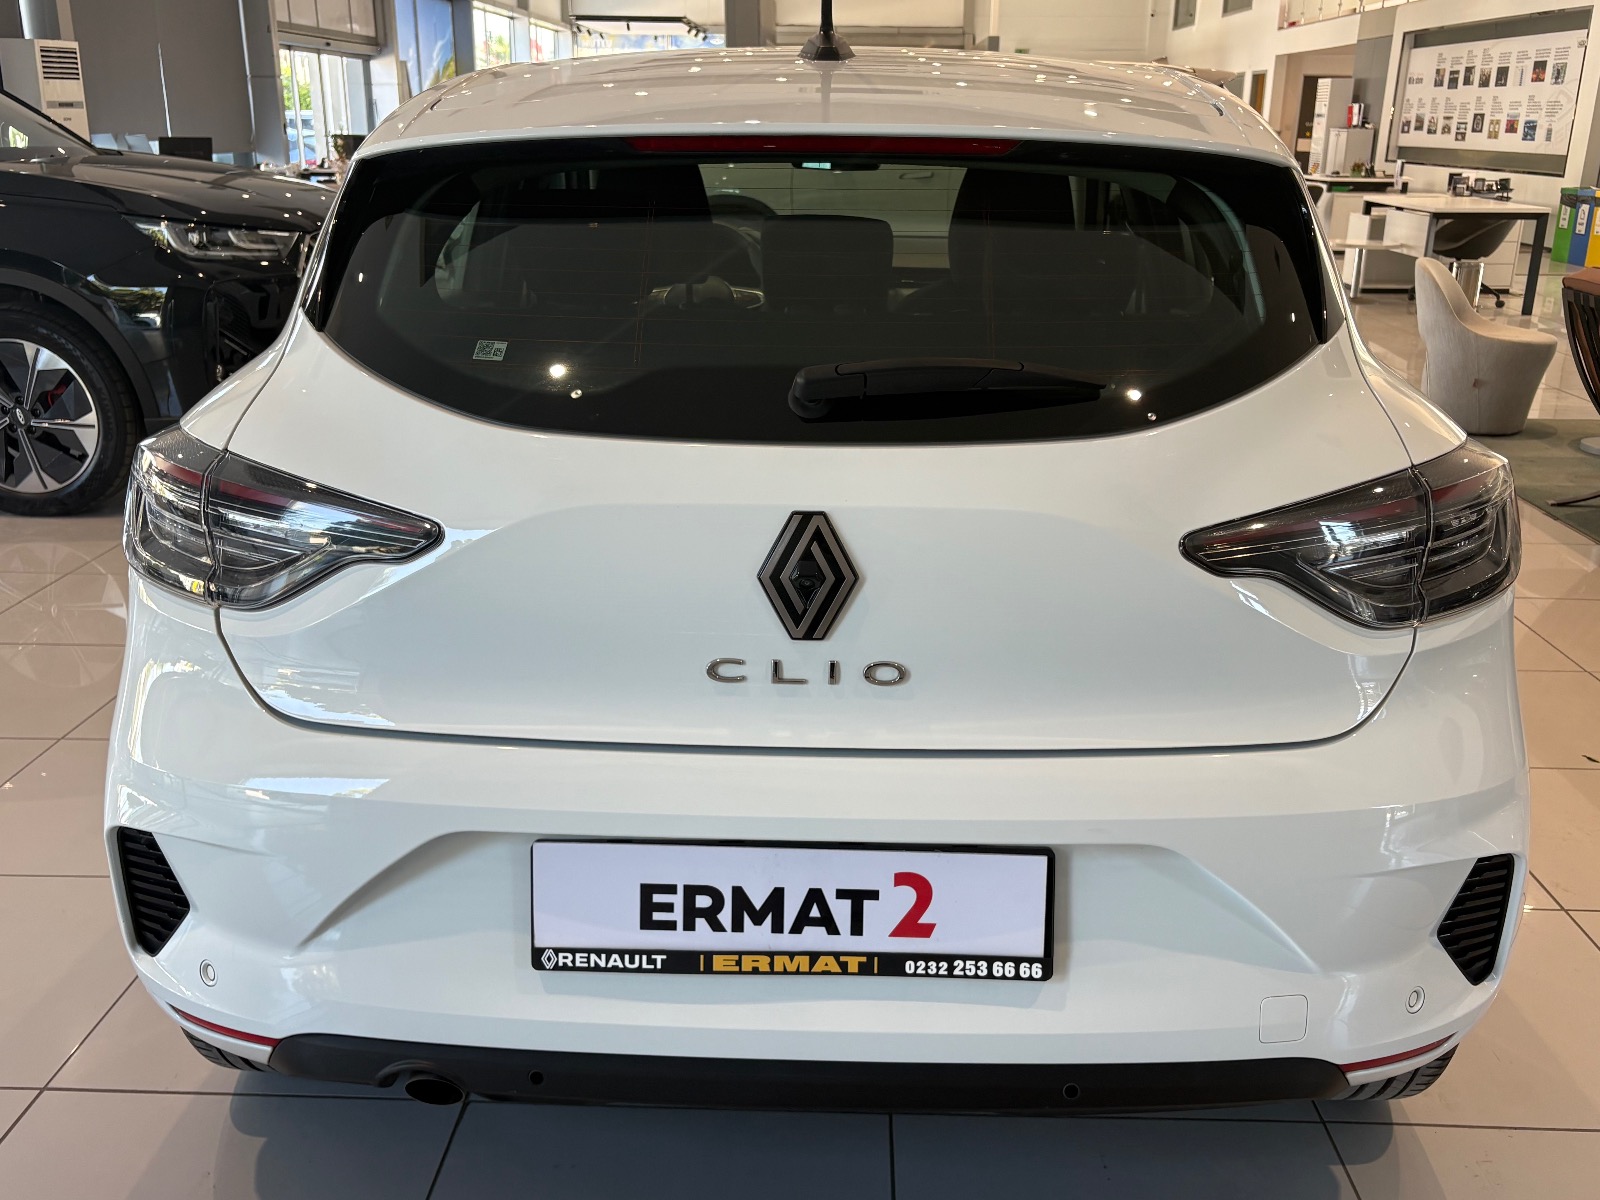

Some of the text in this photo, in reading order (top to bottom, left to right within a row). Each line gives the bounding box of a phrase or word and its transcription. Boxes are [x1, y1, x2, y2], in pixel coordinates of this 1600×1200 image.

[706, 657, 907, 687] CLIO
[639, 871, 937, 938] ERMAT 2
[557, 952, 1043, 979] RENAULT ERMAT 0232 253 66 66
